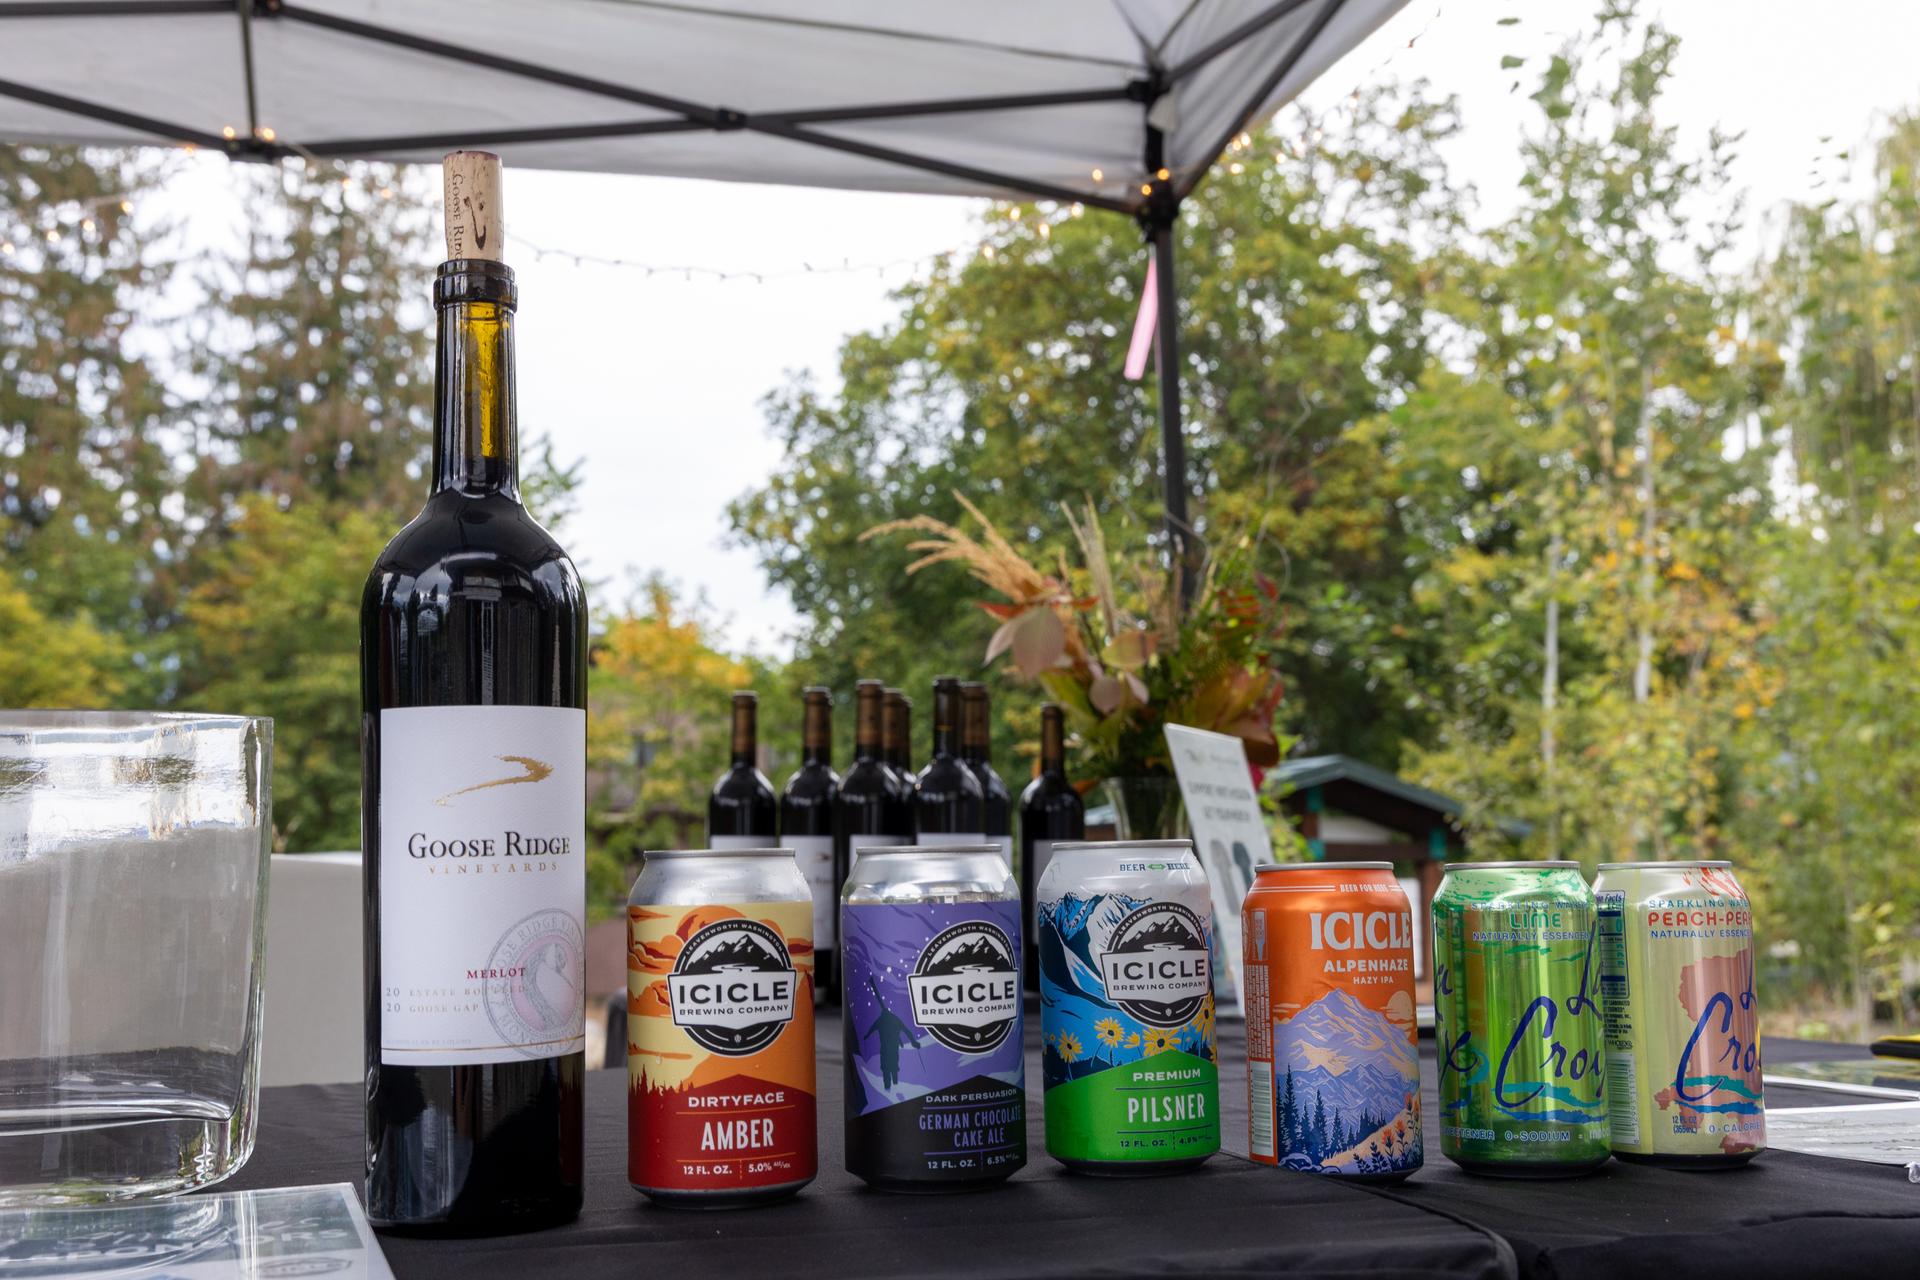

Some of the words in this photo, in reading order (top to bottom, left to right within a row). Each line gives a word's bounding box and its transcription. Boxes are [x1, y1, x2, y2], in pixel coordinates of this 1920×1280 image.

[452, 173, 463, 220] GOOSE
[454, 225, 464, 260] RIDG
[408, 832, 495, 859] GOOSE
[504, 831, 570, 857] RIDGE
[428, 862, 558, 875] VINEYARDS
[1119, 864, 1146, 872] BEER
[1340, 884, 1358, 893] BEER
[1648, 899, 1725, 908] SPARKLING
[1728, 899, 1750, 907] WATE
[1118, 905, 1167, 936] LEAVENWORTH
[1510, 912, 1562, 929] LIME
[1309, 911, 1411, 950] ICICLE
[1472, 931, 1537, 941] NATURALLY
[1650, 930, 1716, 938] NATURALLY
[686, 924, 739, 955] LEAVENWORTH
[741, 923, 784, 953] WASHINGTON
[927, 925, 977, 957] LEAVENWORTH
[467, 967, 526, 979] MERLOT
[1112, 960, 1205, 981] ICICLE
[1323, 959, 1409, 973] ALPENHAZE
[1168, 980, 1206, 990] COMPANY
[1353, 977, 1378, 985] HAZY
[1381, 976, 1394, 984] IPA
[386, 986, 401, 997] 20
[679, 981, 789, 1004] ICICLE
[921, 980, 1014, 1004] ICICLE
[386, 1002, 401, 1013] 20
[453, 1003, 480, 1012] GAP
[679, 1007, 735, 1016] BREWING
[738, 1004, 790, 1015] COMPANY
[921, 1007, 974, 1016] BREWING
[977, 1003, 1015, 1014] COMPANY
[1132, 1068, 1201, 1082] PREMIUM
[688, 1091, 785, 1108] DIRTYFACE
[926, 1095, 957, 1103] DARK
[961, 1088, 1017, 1101] PERSUASION
[1127, 1093, 1205, 1123] PILSNER
[919, 1113, 970, 1130] GERMAN
[701, 1118, 774, 1151] AMBER
[954, 1129, 984, 1147] CAKE
[987, 1127, 1005, 1145] ALE
[1504, 1131, 1571, 1142] 0-SODIUM
[683, 1165, 694, 1175] 12
[696, 1165, 711, 1175] FL.
[713, 1164, 733, 1175] OZ.
[748, 1162, 773, 1173] 5.0%
[927, 1161, 939, 1169] 12
[941, 1161, 957, 1169] FL.
[959, 1159, 976, 1167] OZ.
